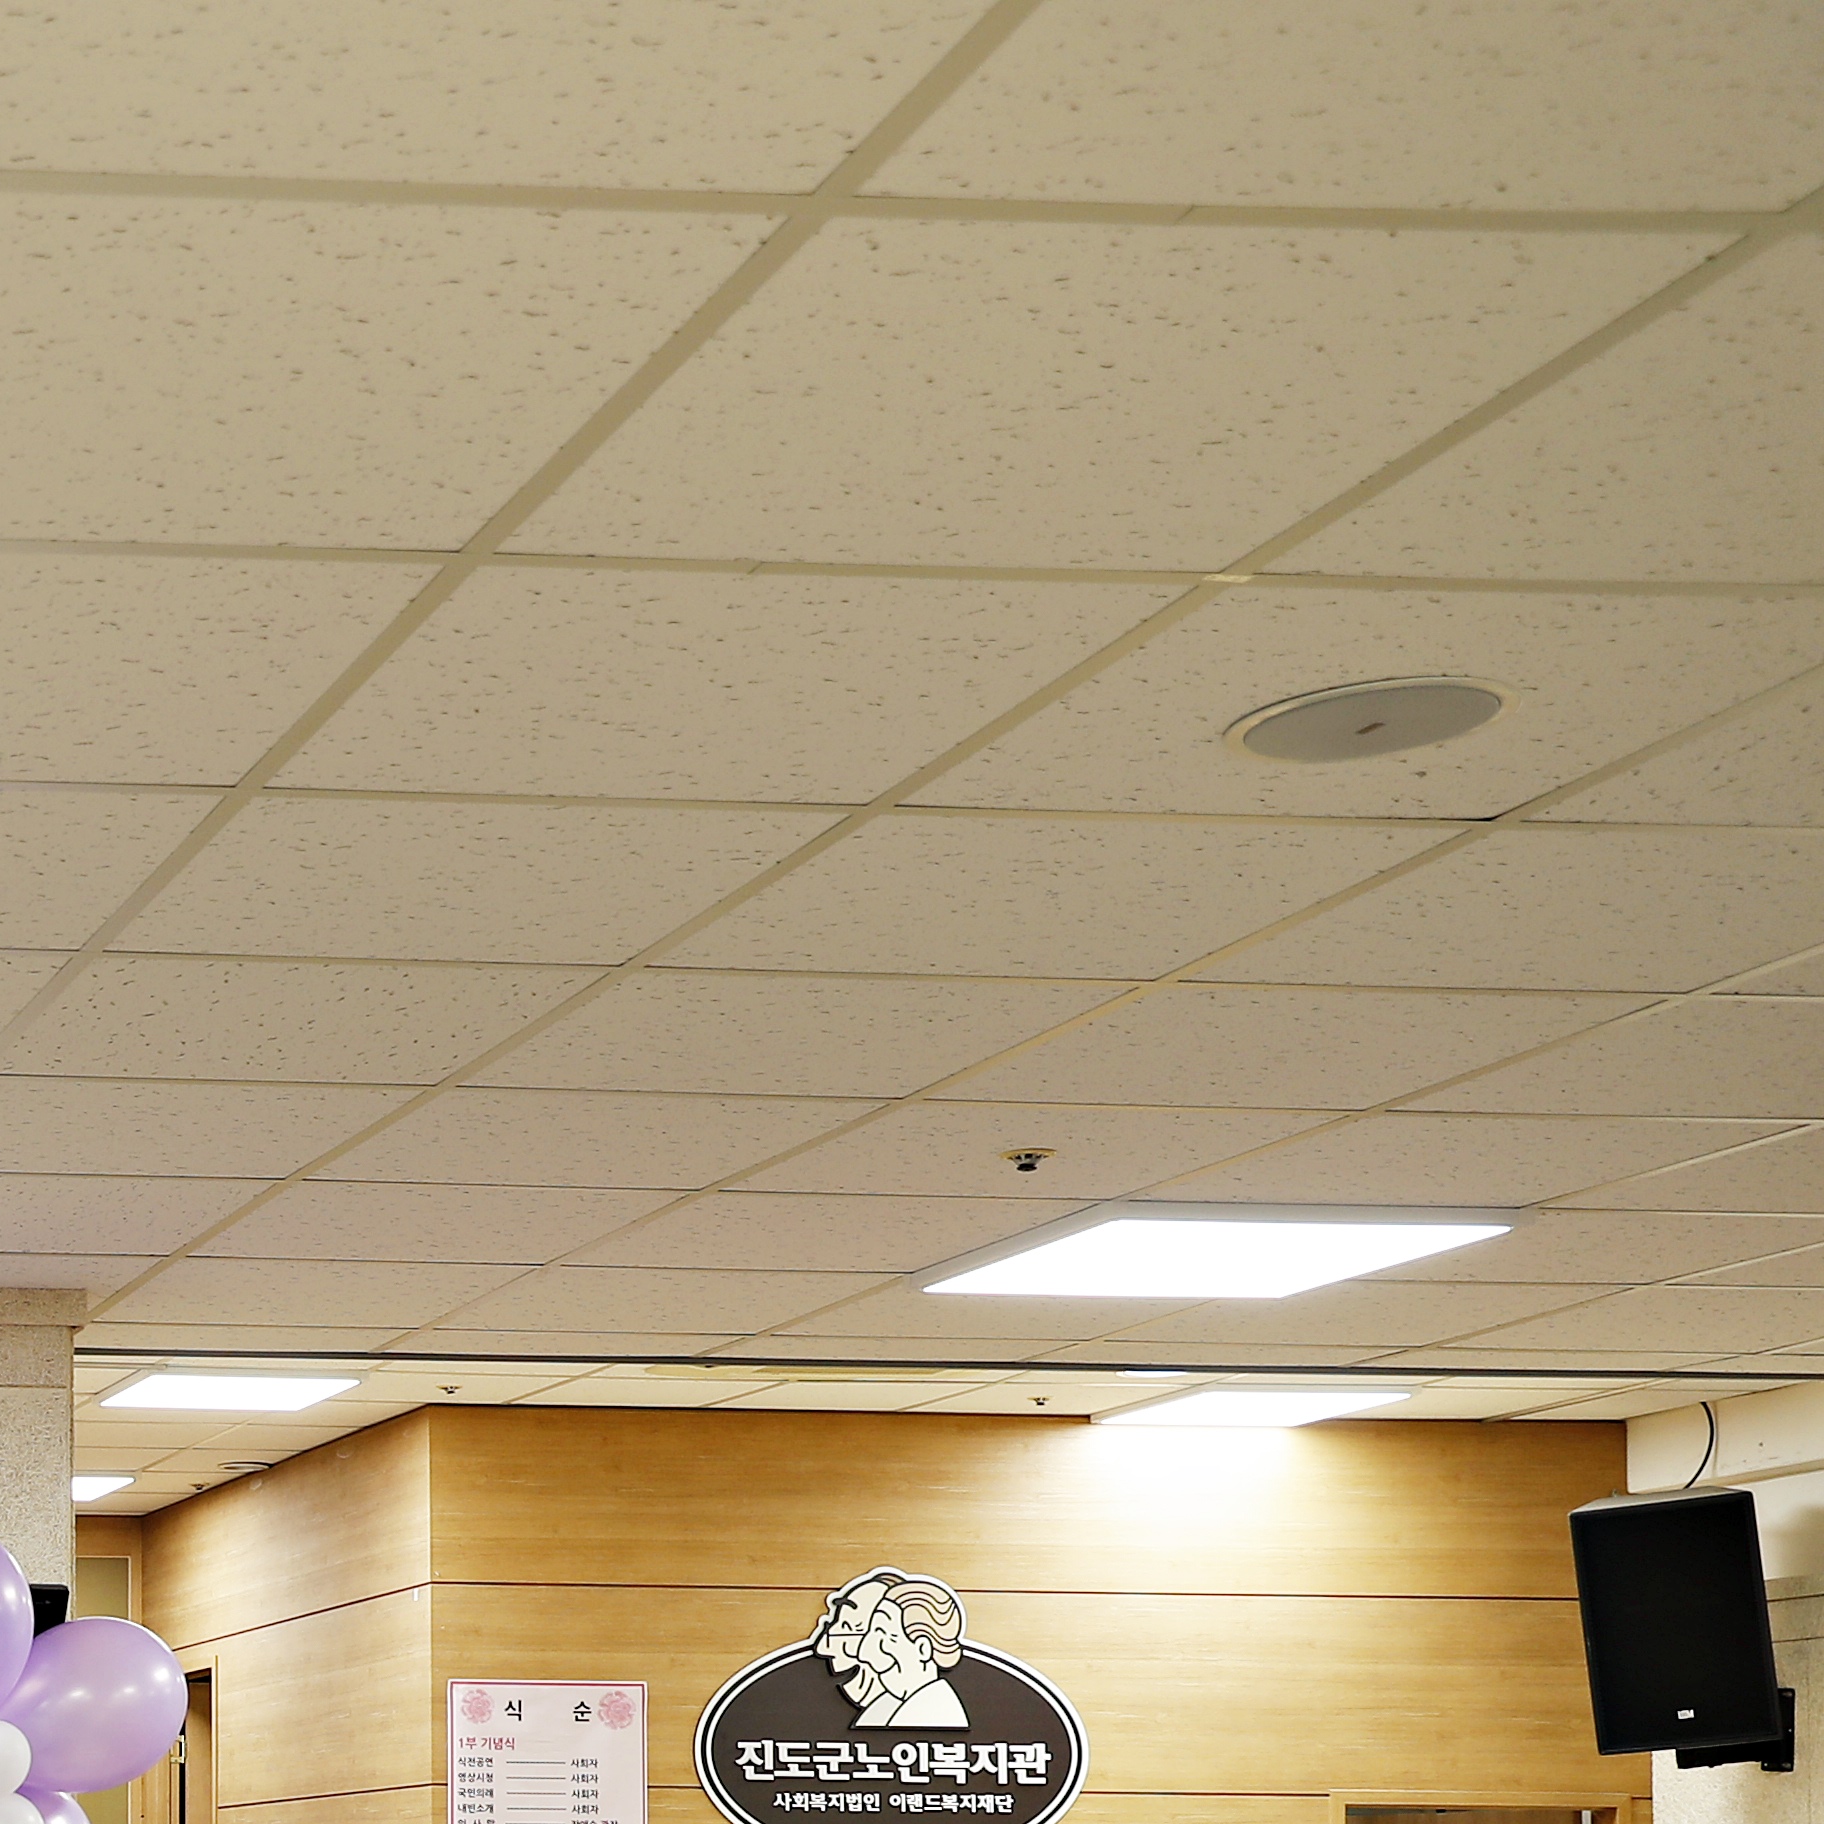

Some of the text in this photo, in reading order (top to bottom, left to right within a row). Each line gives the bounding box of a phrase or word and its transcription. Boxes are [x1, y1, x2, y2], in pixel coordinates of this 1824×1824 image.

[504, 1699, 592, 1722] 식 순
[458, 1737, 515, 1750] 1부 기념식
[735, 1739, 1052, 1785] 진도군노인복지관
[773, 1792, 1014, 1814] 사회복지법인 이랜드복지재단
